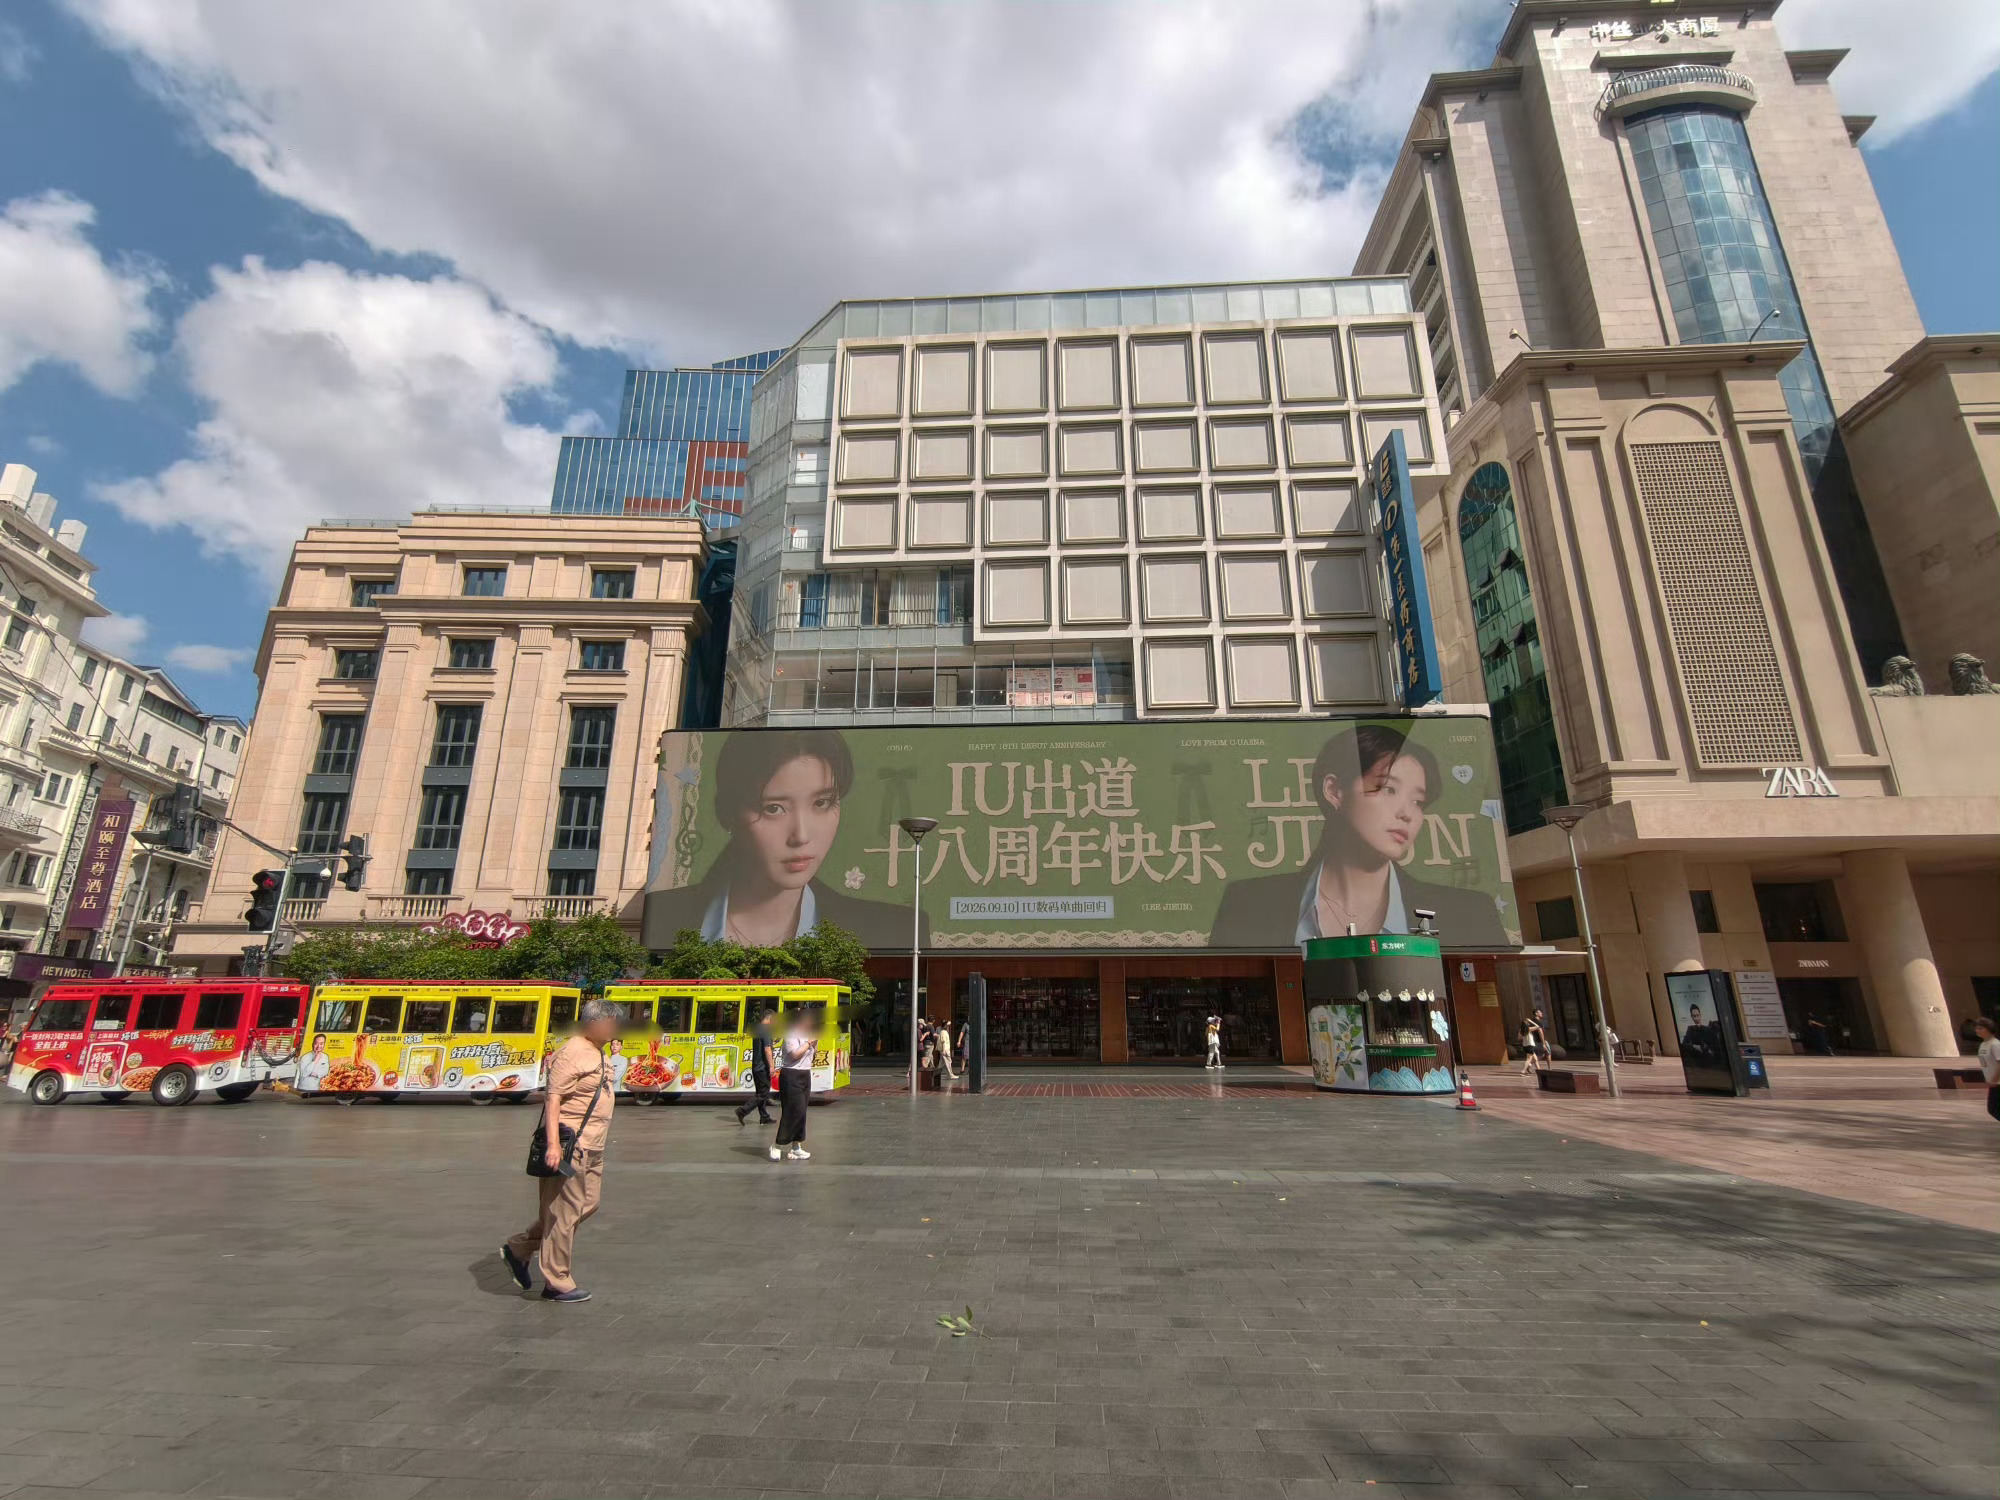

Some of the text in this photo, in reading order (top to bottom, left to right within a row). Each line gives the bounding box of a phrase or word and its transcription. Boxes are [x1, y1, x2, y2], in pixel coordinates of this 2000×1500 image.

[1021, 742, 1048, 750] DEBUT
[1049, 741, 1106, 750] ANNIVERSARY
[1181, 739, 1202, 747] LOVE
[946, 757, 1139, 819] IU出道
[1243, 759, 1319, 808] LE
[1761, 765, 1839, 797] ZARA
[79, 814, 121, 910] 和颐至尊酒店
[863, 820, 1227, 887] 十八周年快乐
[956, 901, 1106, 914] [2026.09.10] IU数码单曲回归
[42, 966, 93, 978] HEYI HOTEL
